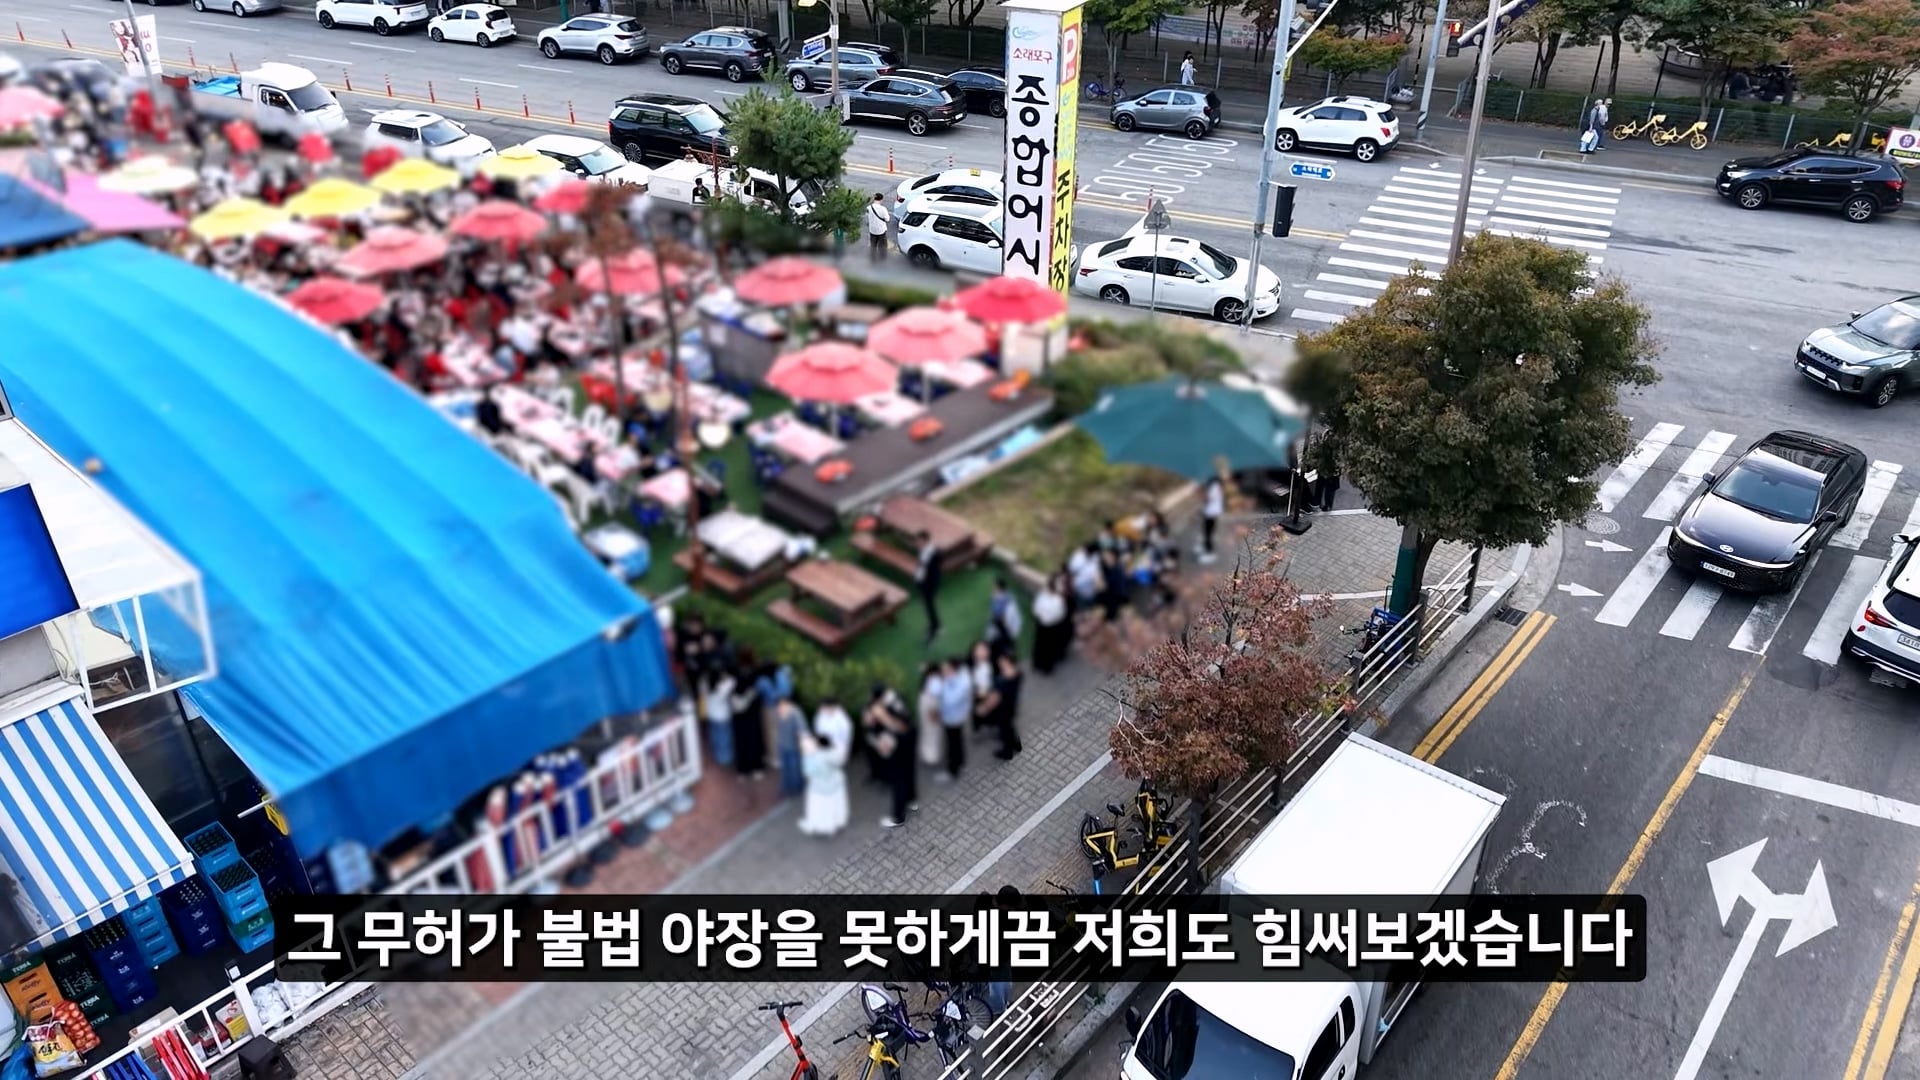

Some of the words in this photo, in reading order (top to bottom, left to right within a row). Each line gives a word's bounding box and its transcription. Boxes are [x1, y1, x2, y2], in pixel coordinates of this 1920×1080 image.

[1013, 47, 1053, 64] 소래포구
[1062, 29, 1078, 83] P
[1053, 169, 1071, 292] 주차장
